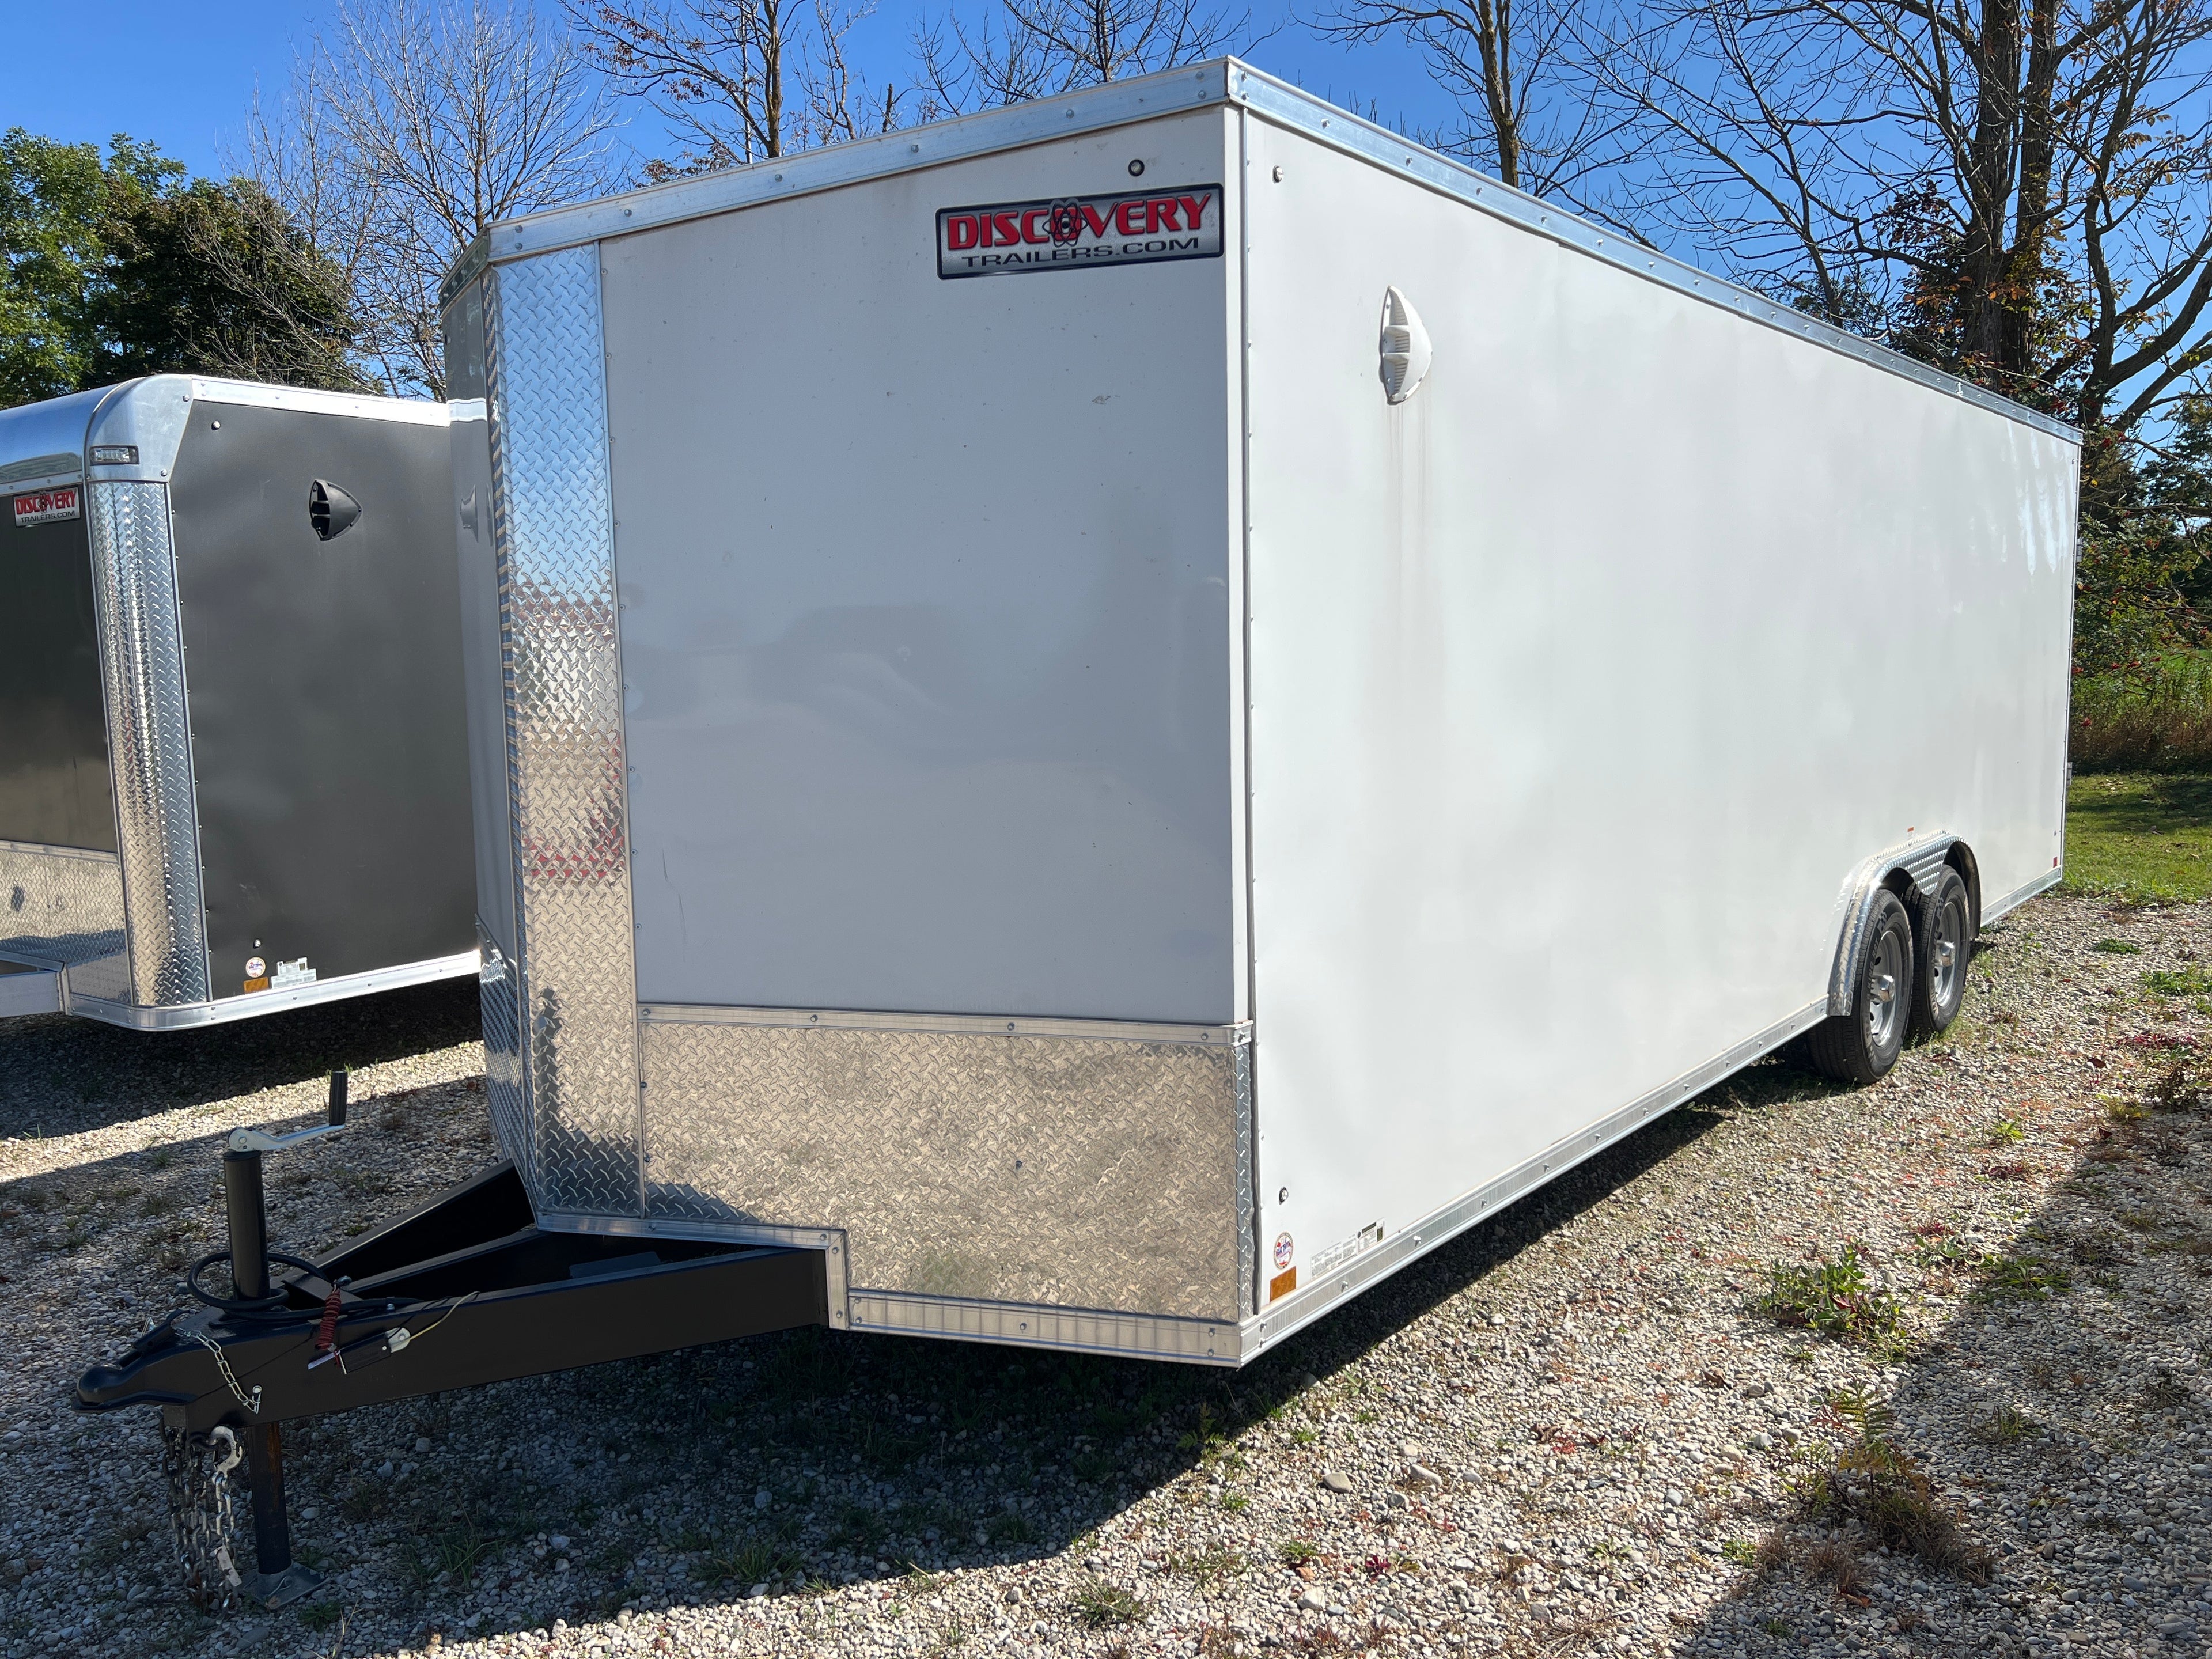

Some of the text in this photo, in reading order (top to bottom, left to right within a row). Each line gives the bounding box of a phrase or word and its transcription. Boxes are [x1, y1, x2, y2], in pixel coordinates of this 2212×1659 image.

[948, 194, 1211, 249] DISCOVERY
[962, 238, 1199, 267] TRAILERS.COM
[16, 490, 76, 514] DISCOVERY
[21, 510, 75, 523] TRAILERS.COM
